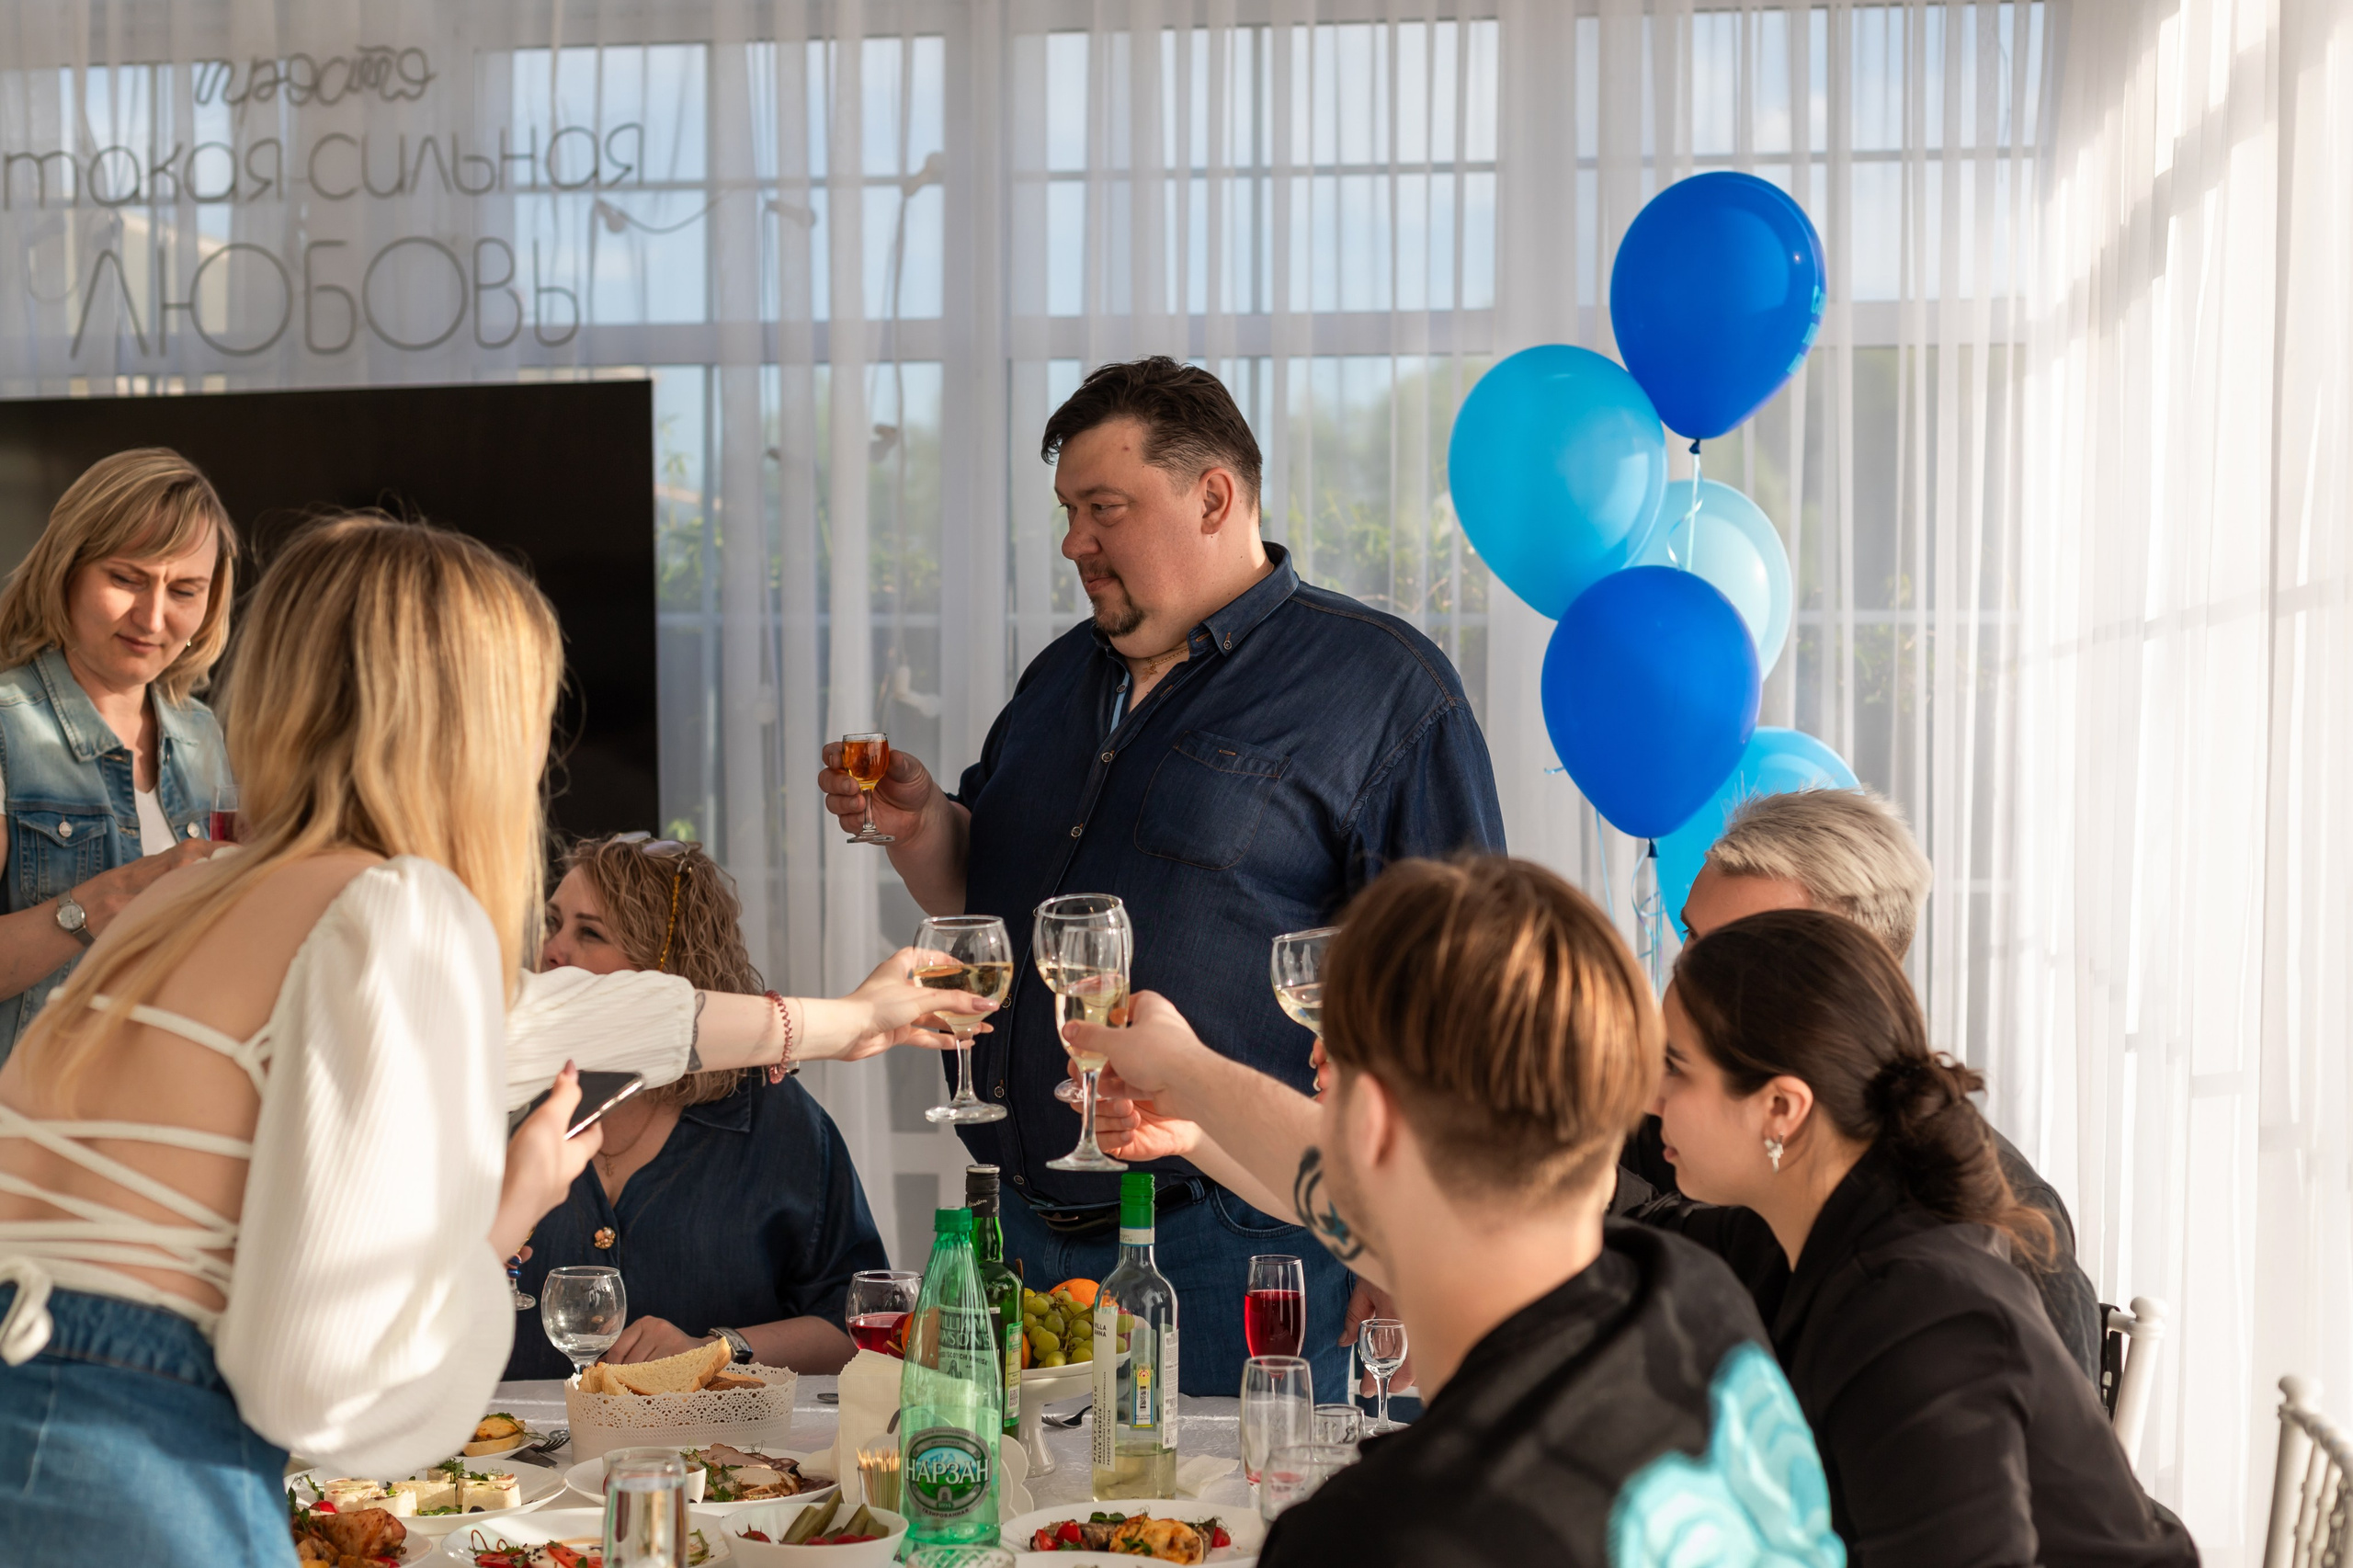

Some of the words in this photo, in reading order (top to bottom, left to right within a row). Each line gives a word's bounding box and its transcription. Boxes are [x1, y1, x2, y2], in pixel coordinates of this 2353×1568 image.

[192, 44, 437, 123] просто
[3, 137, 283, 211] такая
[308, 121, 645, 201] сильная
[69, 235, 581, 359] ЛЮБОВЬ
[1094, 1329, 1107, 1337] ANNA
[1095, 1322, 1107, 1331] VILLA
[905, 1458, 990, 1484] НАРЗАН
[921, 1507, 970, 1518] ГАЗИРОВАННАЯ
